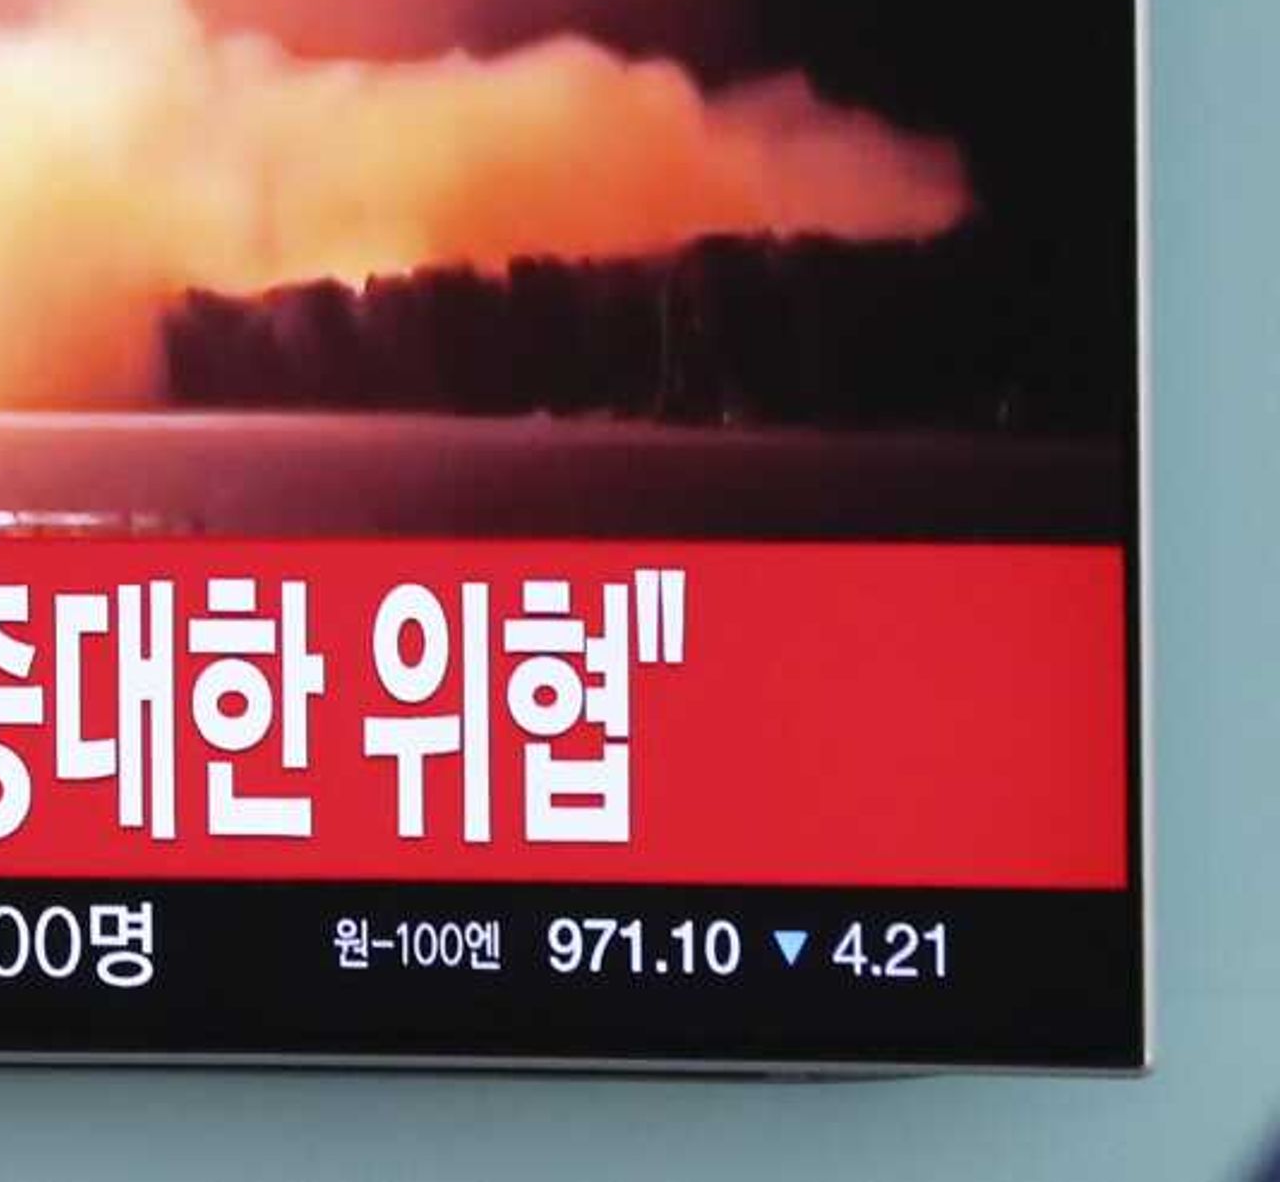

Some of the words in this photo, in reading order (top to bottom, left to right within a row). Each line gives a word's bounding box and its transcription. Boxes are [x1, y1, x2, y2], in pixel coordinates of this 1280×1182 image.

[363, 569, 686, 843] 위협"
[334, 918, 502, 971] 원-100엔
[547, 918, 741, 974] 971.10
[831, 922, 949, 979] 4.21
